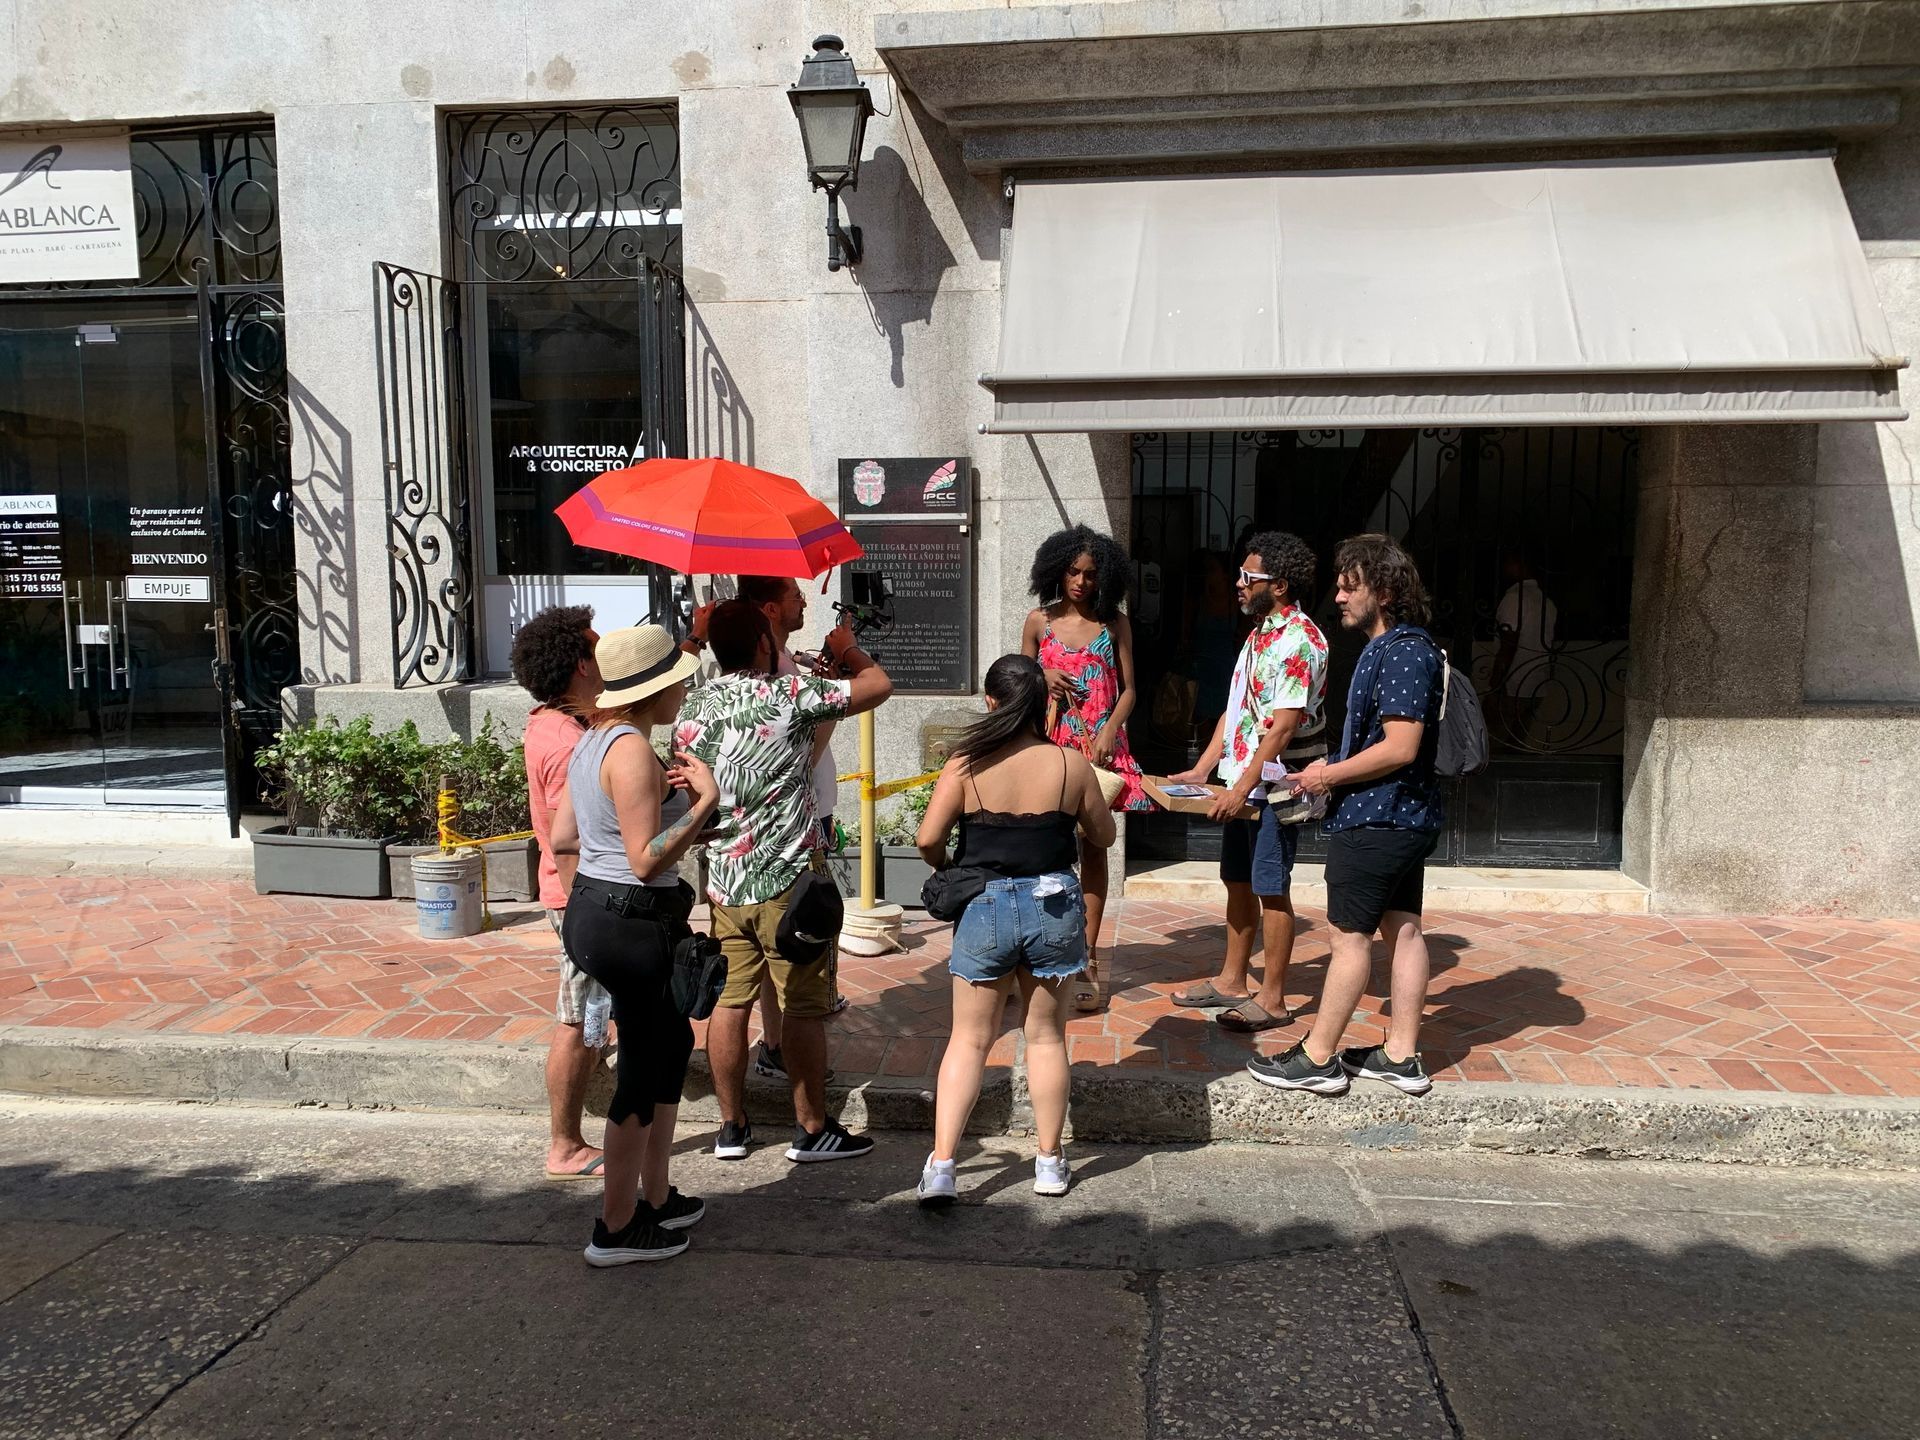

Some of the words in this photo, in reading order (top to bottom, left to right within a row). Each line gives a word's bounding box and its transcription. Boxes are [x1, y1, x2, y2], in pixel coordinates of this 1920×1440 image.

[75, 241, 122, 250] CARTAGENA
[509, 446, 629, 458] ARQUITECTURA
[526, 460, 537, 472] &
[540, 460, 625, 472] CONCRETO
[923, 492, 956, 500] IPCC
[130, 507, 140, 515] Un
[168, 509, 180, 517] que
[181, 507, 196, 515] será
[197, 506, 204, 514] el
[12, 520, 23, 530] de
[25, 520, 59, 529] atención
[130, 518, 149, 528] lugar
[611, 516, 631, 526] UNITED
[163, 528, 171, 536] de
[172, 528, 207, 536] Colombia.
[909, 543, 919, 551] EN
[920, 543, 945, 551] DONDE
[947, 543, 961, 551] FUE
[131, 553, 207, 564] BIENVENIDO
[898, 552, 908, 561] EN
[908, 552, 919, 561] EL
[919, 551, 935, 561] AÑO
[935, 553, 945, 561] DE
[850, 562, 863, 570] EL
[865, 562, 913, 570] PRESENTE
[917, 562, 961, 570] EDIFICIO
[4, 574, 20, 582] 315
[21, 574, 37, 582] 731
[40, 573, 61, 581] 6747
[4, 585, 20, 593] 311
[22, 584, 39, 592] 705
[40, 584, 62, 592] 5555
[895, 580, 926, 588] FAMOSO
[144, 583, 191, 596] EMPUJE
[930, 590, 956, 598] HOTEL
